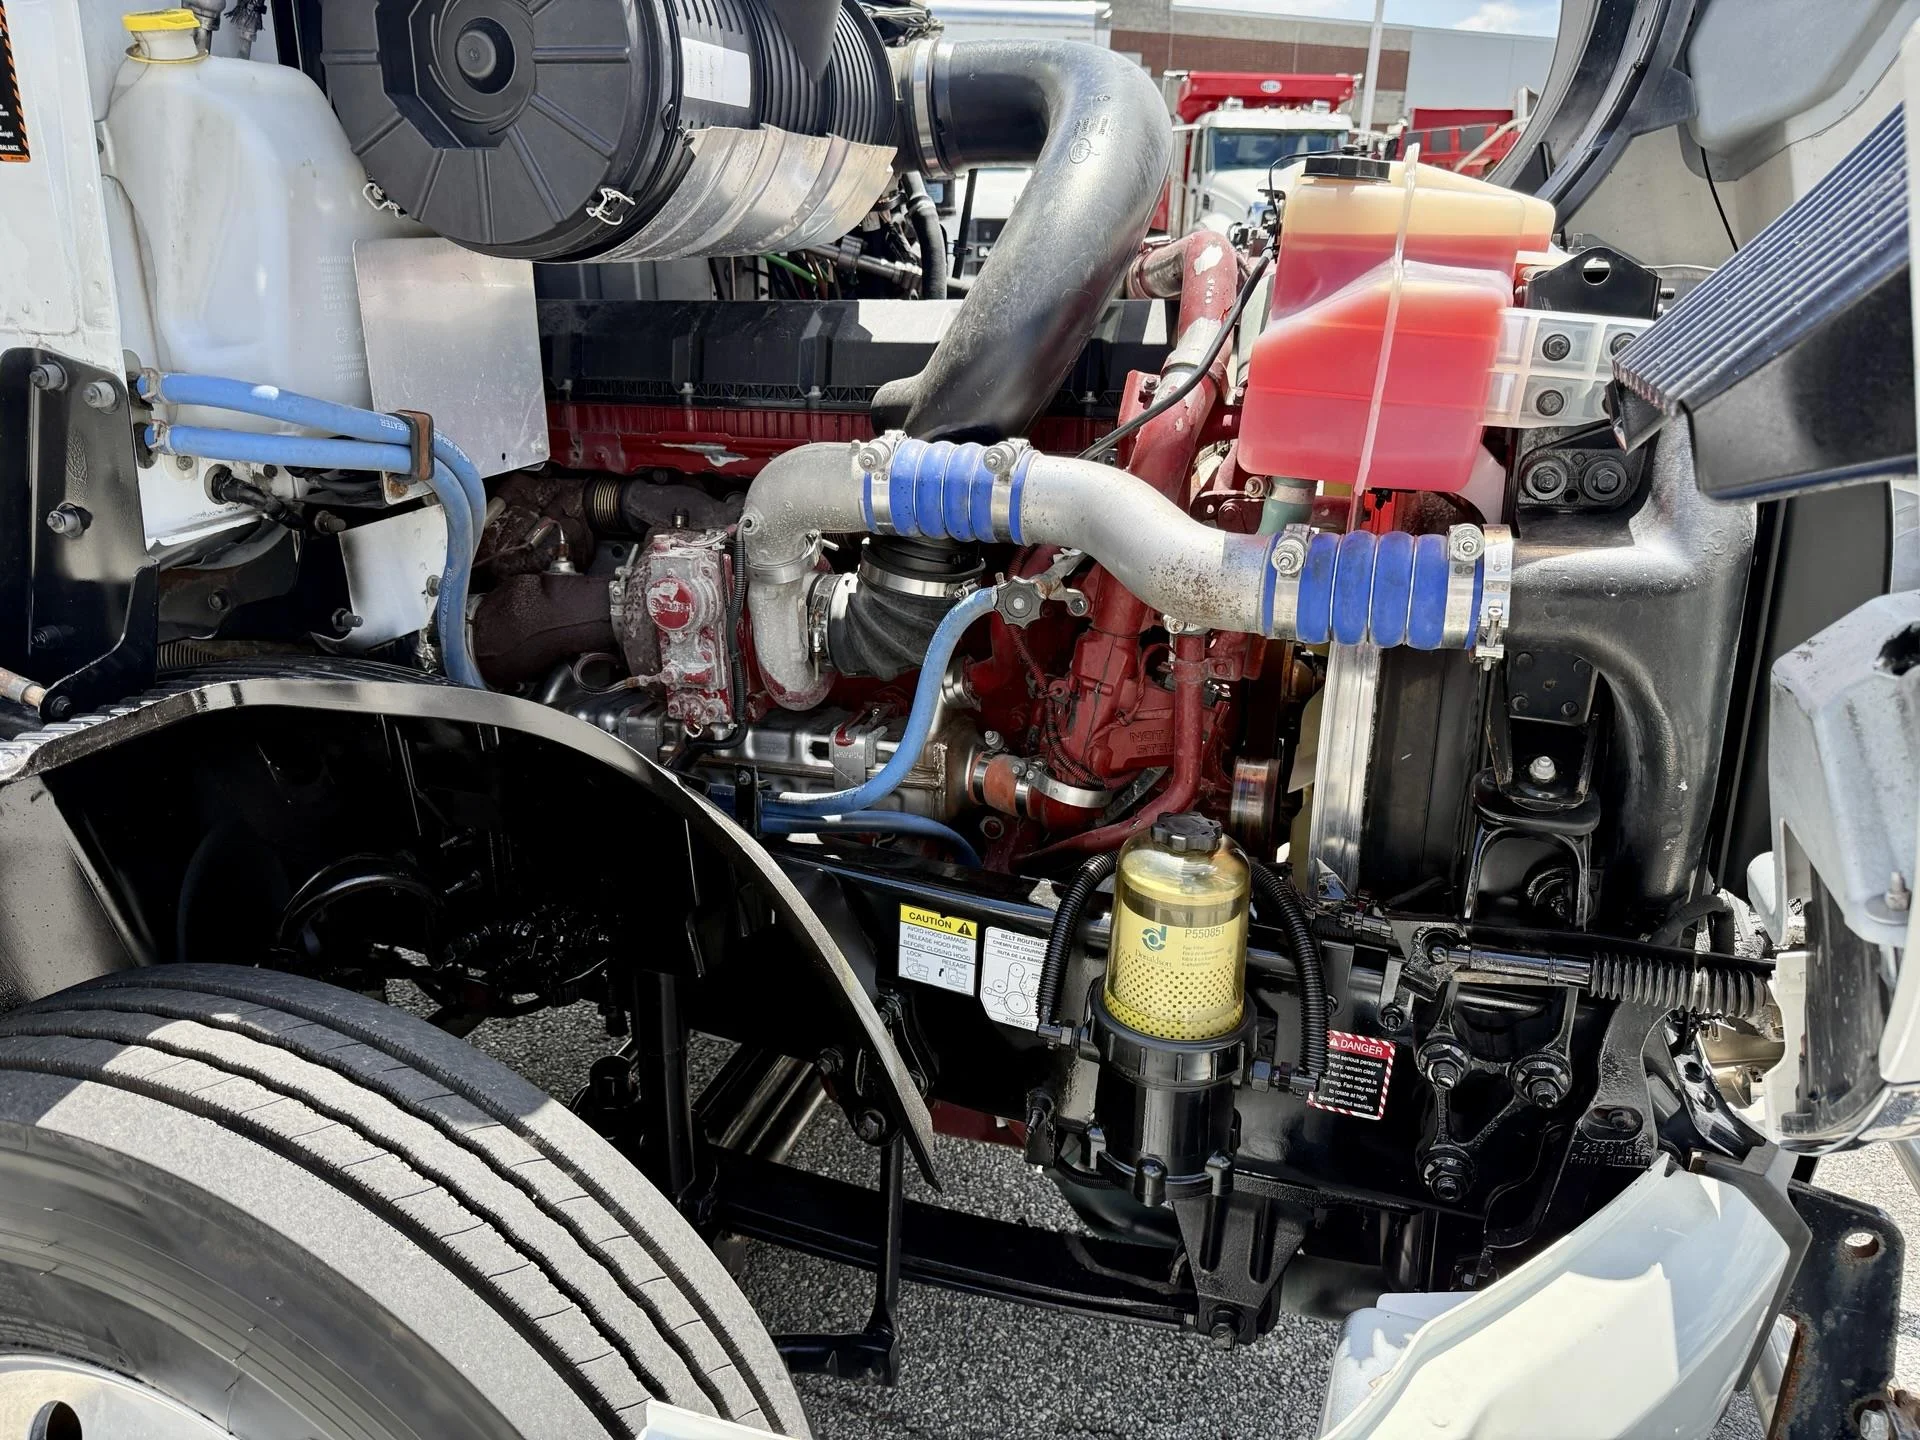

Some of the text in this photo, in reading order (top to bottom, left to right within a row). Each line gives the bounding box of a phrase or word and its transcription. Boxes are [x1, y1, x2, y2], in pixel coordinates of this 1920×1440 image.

[909, 912, 952, 929] CAUTION
[907, 926, 924, 934] AVOID
[925, 930, 942, 939] HOOD
[1184, 926, 1224, 939] P550851
[908, 933, 932, 944] RELEASE
[934, 940, 951, 949] HOOD
[1000, 933, 1045, 948] BELT ROUTING
[903, 940, 971, 961] BEFORE CLOSING HOOD
[906, 950, 921, 958] LOCK
[992, 940, 1012, 949] CHEMIN
[1021, 946, 1046, 956] COURROI
[997, 949, 1010, 957] RUTA
[942, 959, 967, 969] RELEASE
[1340, 1039, 1383, 1056] DANGER
[1341, 1055, 1359, 1063] serious
[1360, 1059, 1382, 1068] personal
[1345, 1065, 1362, 1073] remain
[1363, 1068, 1376, 1076] clear
[1354, 1075, 1372, 1084] engine
[1353, 1084, 1364, 1092] may
[1318, 1095, 1335, 1103] speed
[1353, 1103, 1374, 1112] warning.
